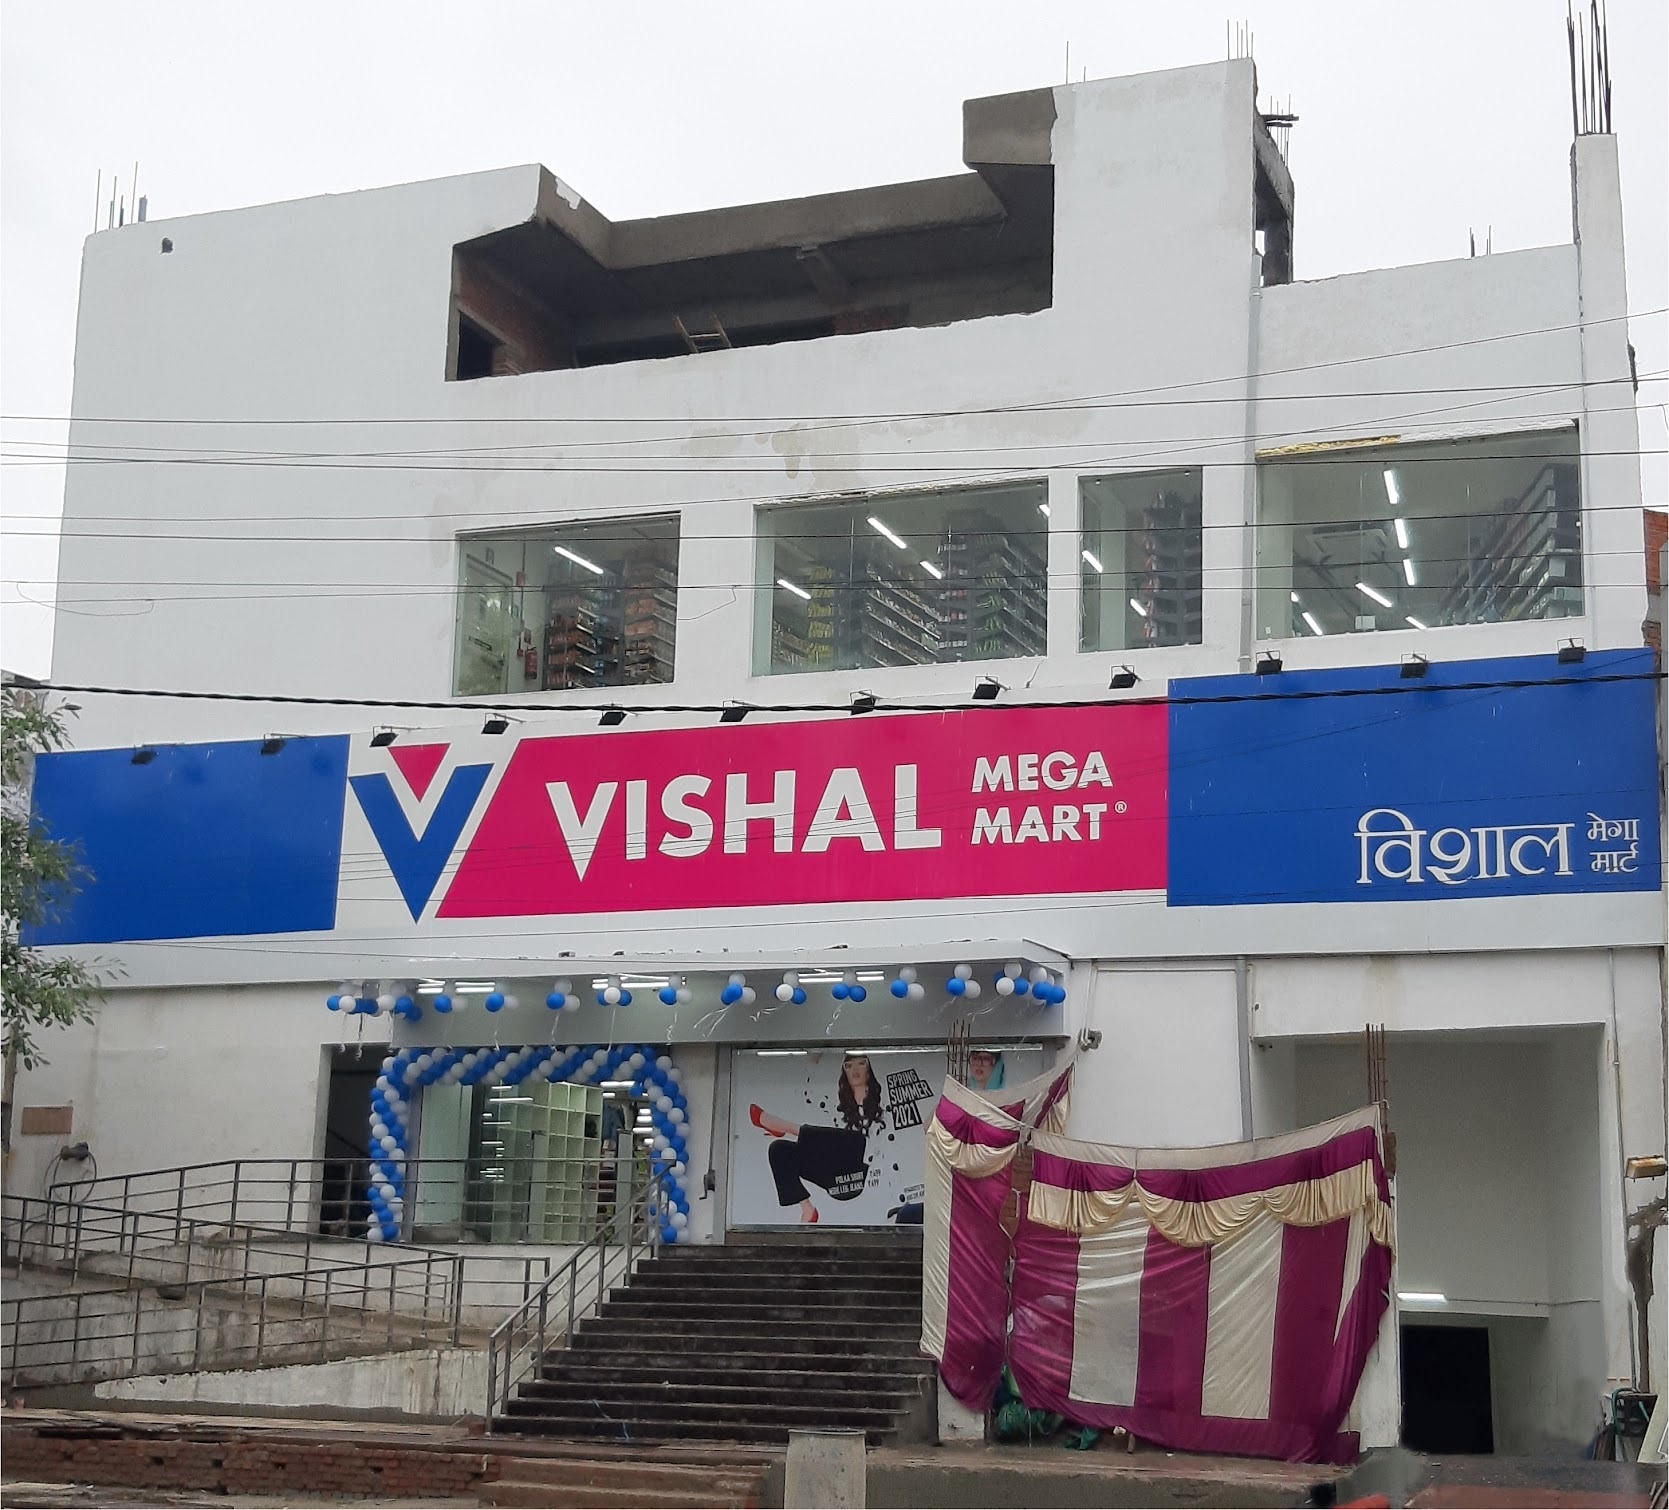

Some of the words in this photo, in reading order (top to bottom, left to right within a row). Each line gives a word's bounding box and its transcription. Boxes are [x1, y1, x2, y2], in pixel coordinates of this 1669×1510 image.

[971, 751, 1113, 793] MEGA
[545, 763, 942, 882] VISHAL
[1586, 812, 1640, 842] मेगा
[1353, 808, 1576, 885] विशाल
[1588, 841, 1640, 873] मार्ट
[887, 1070, 918, 1089] SPRING
[890, 1081, 932, 1105] SUMMER
[893, 1102, 920, 1128] 2021
